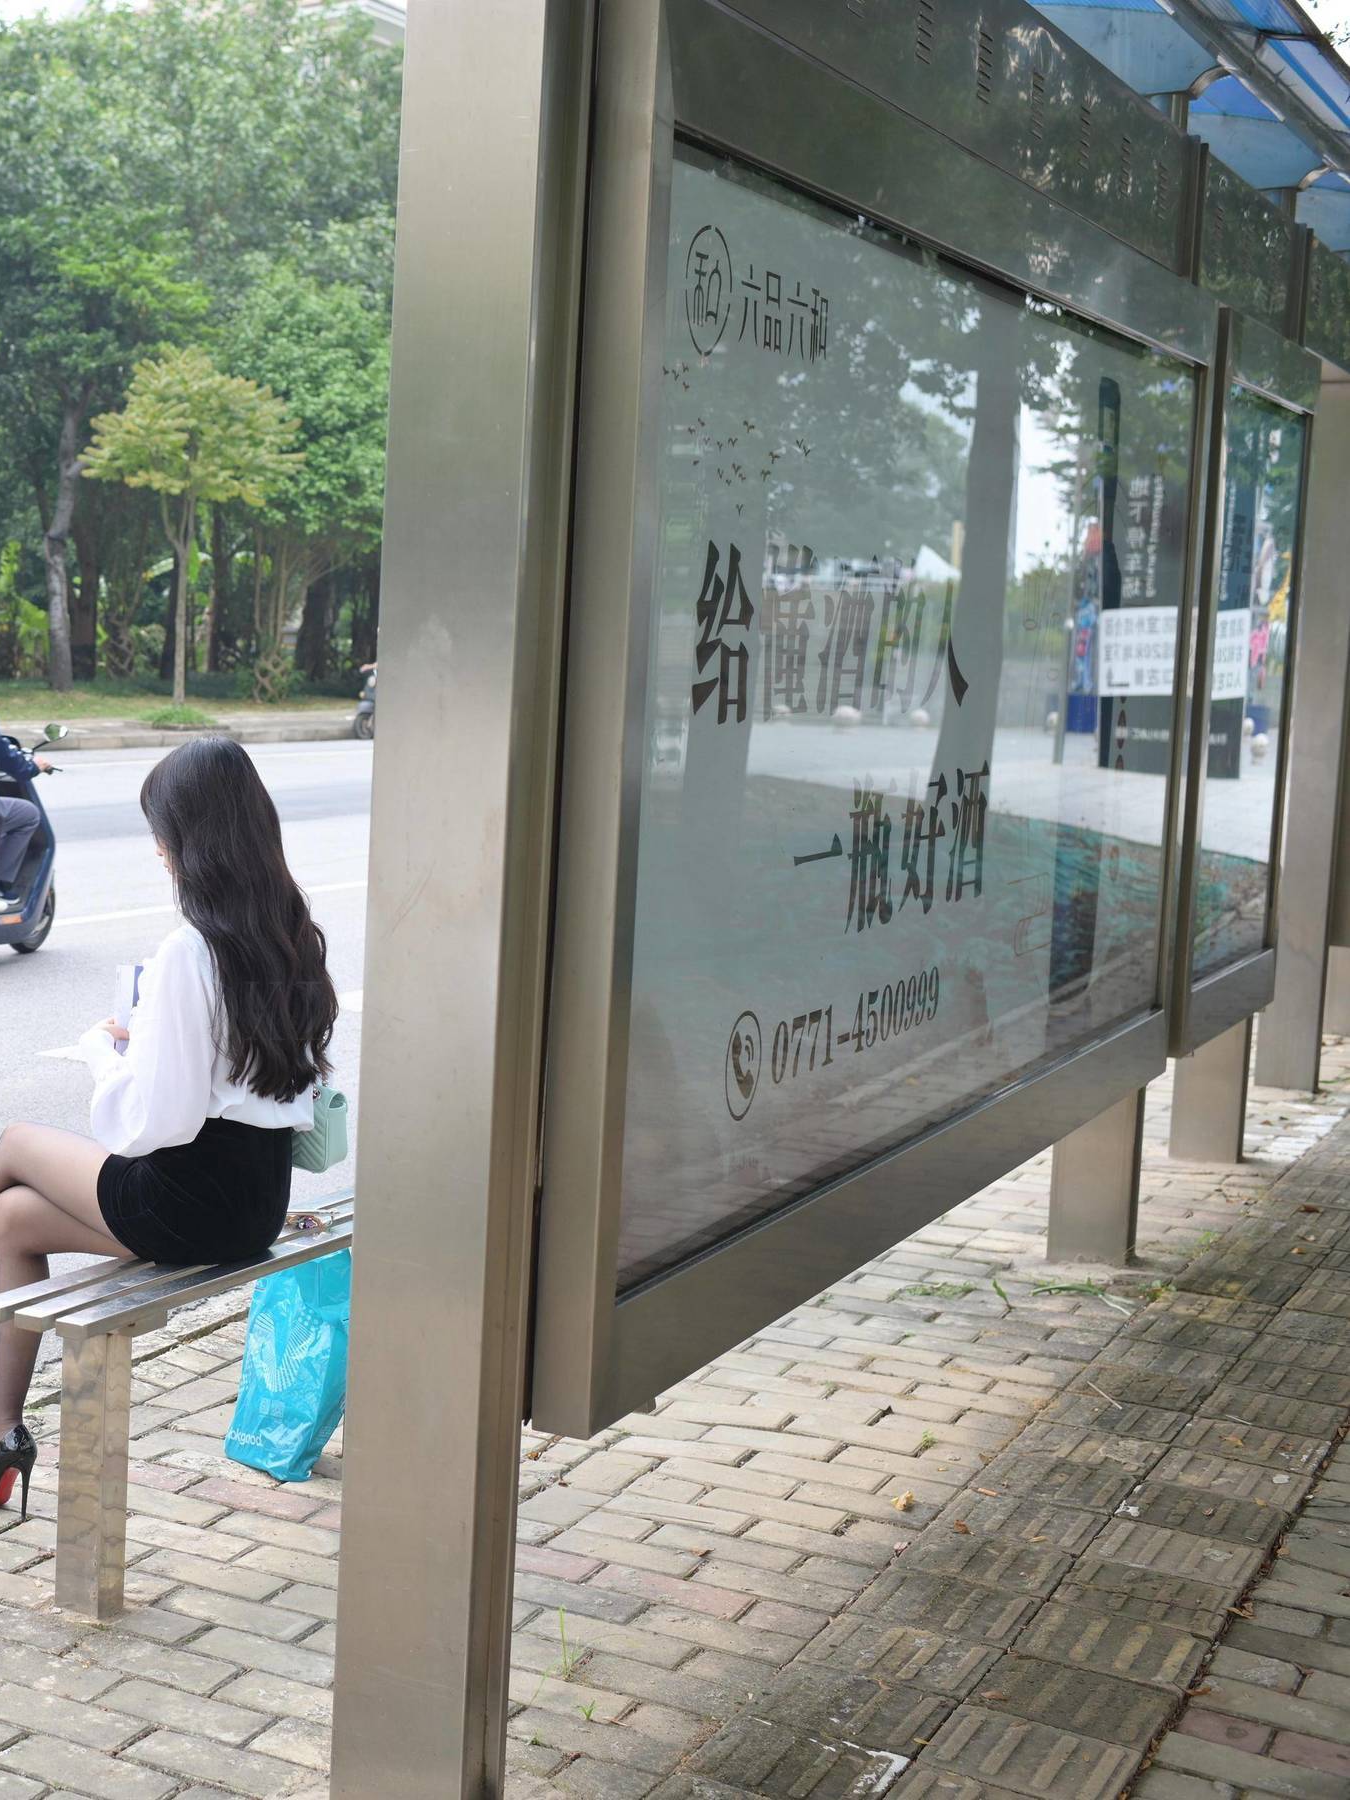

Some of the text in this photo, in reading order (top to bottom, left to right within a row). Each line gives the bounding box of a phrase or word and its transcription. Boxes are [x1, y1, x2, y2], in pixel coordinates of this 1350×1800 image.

[738, 263, 829, 364] 六品六和
[793, 760, 990, 935] 一瓶好酒
[771, 966, 940, 1084] 0771-4500999
